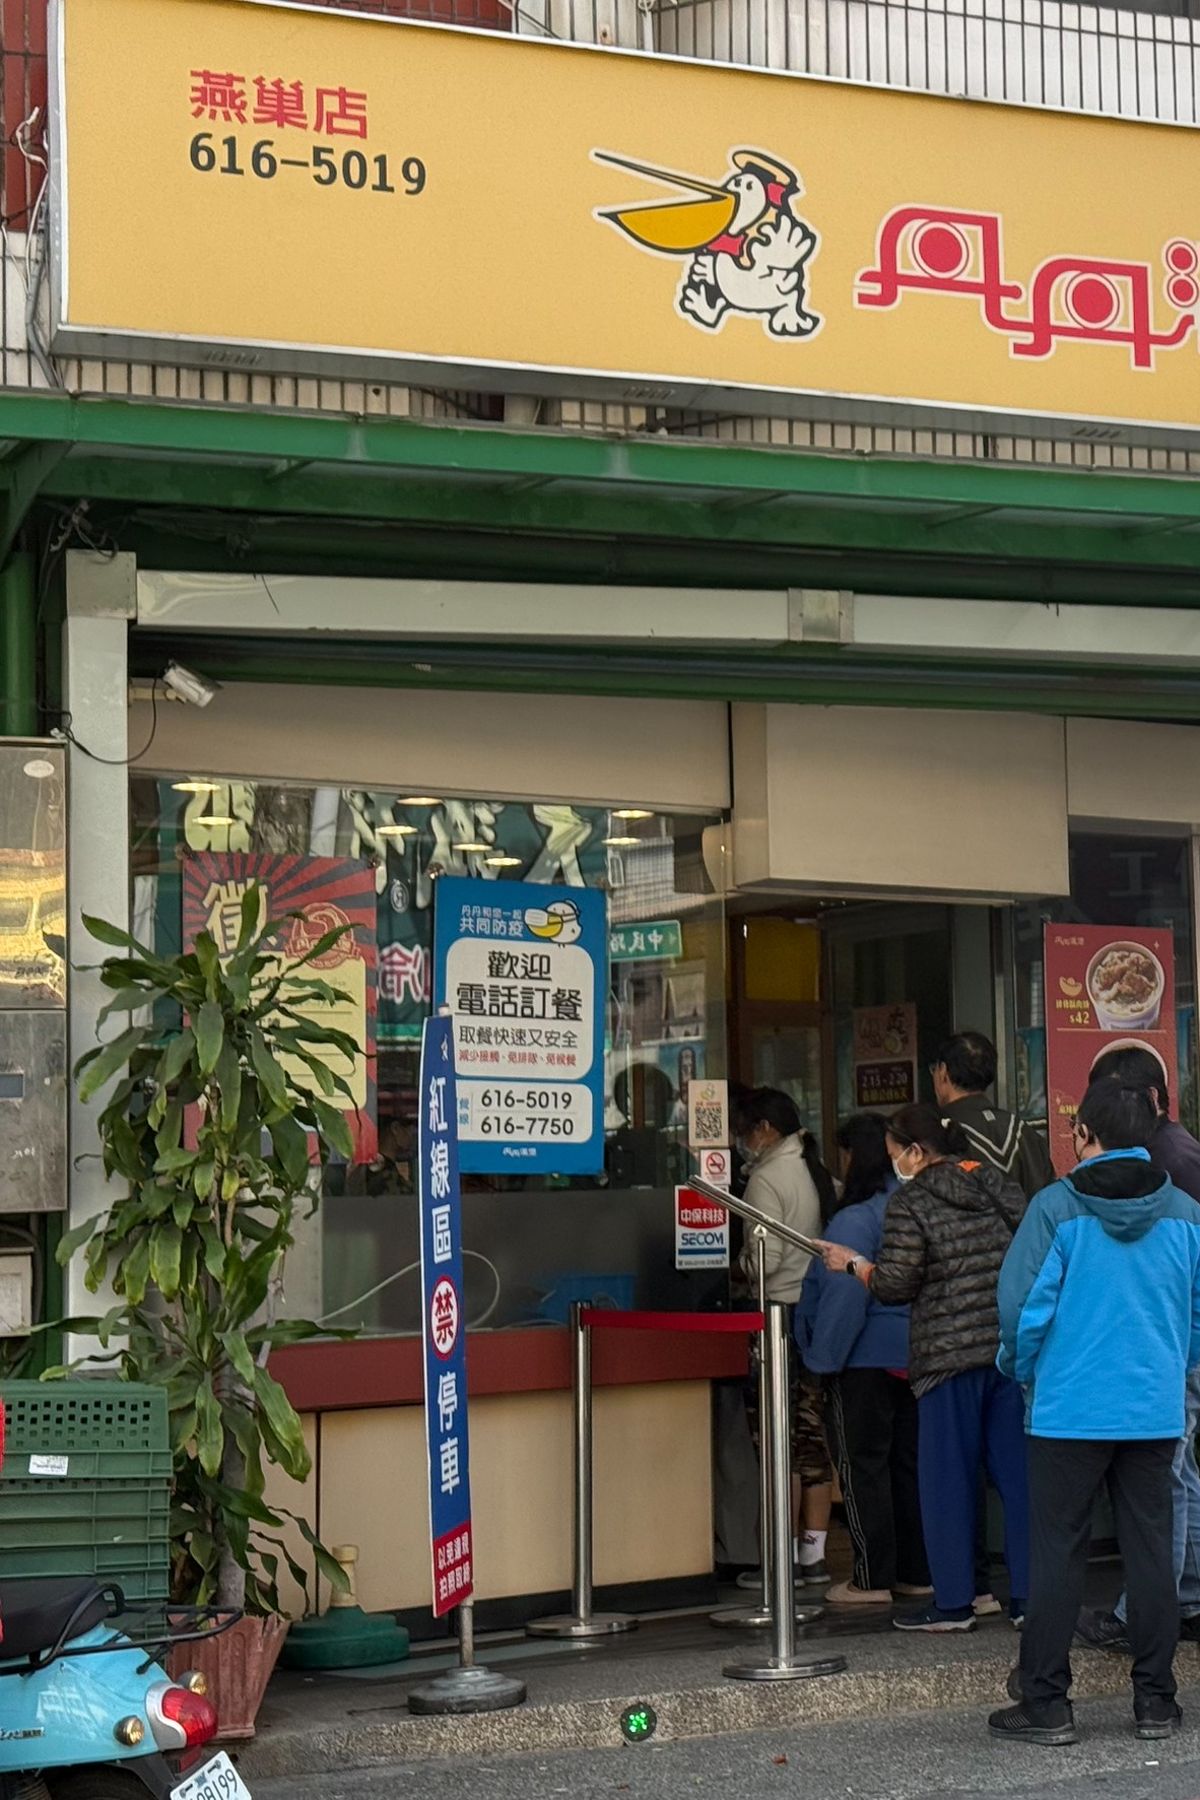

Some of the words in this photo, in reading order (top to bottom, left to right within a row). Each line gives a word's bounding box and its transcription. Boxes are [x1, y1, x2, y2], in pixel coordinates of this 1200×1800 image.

[190, 69, 368, 139] 燕巢店
[190, 132, 426, 195] 616-5019
[459, 917, 524, 937] 共同防疫
[487, 950, 552, 981] 歡迎
[456, 982, 583, 1021] 電話訂餐
[459, 1025, 578, 1049] 取餐快速又安全
[481, 1089, 573, 1110] 616-5019
[480, 1115, 574, 1136] 616-7750
[680, 1207, 725, 1225] 中保科技
[681, 1231, 725, 1246] SECOM
